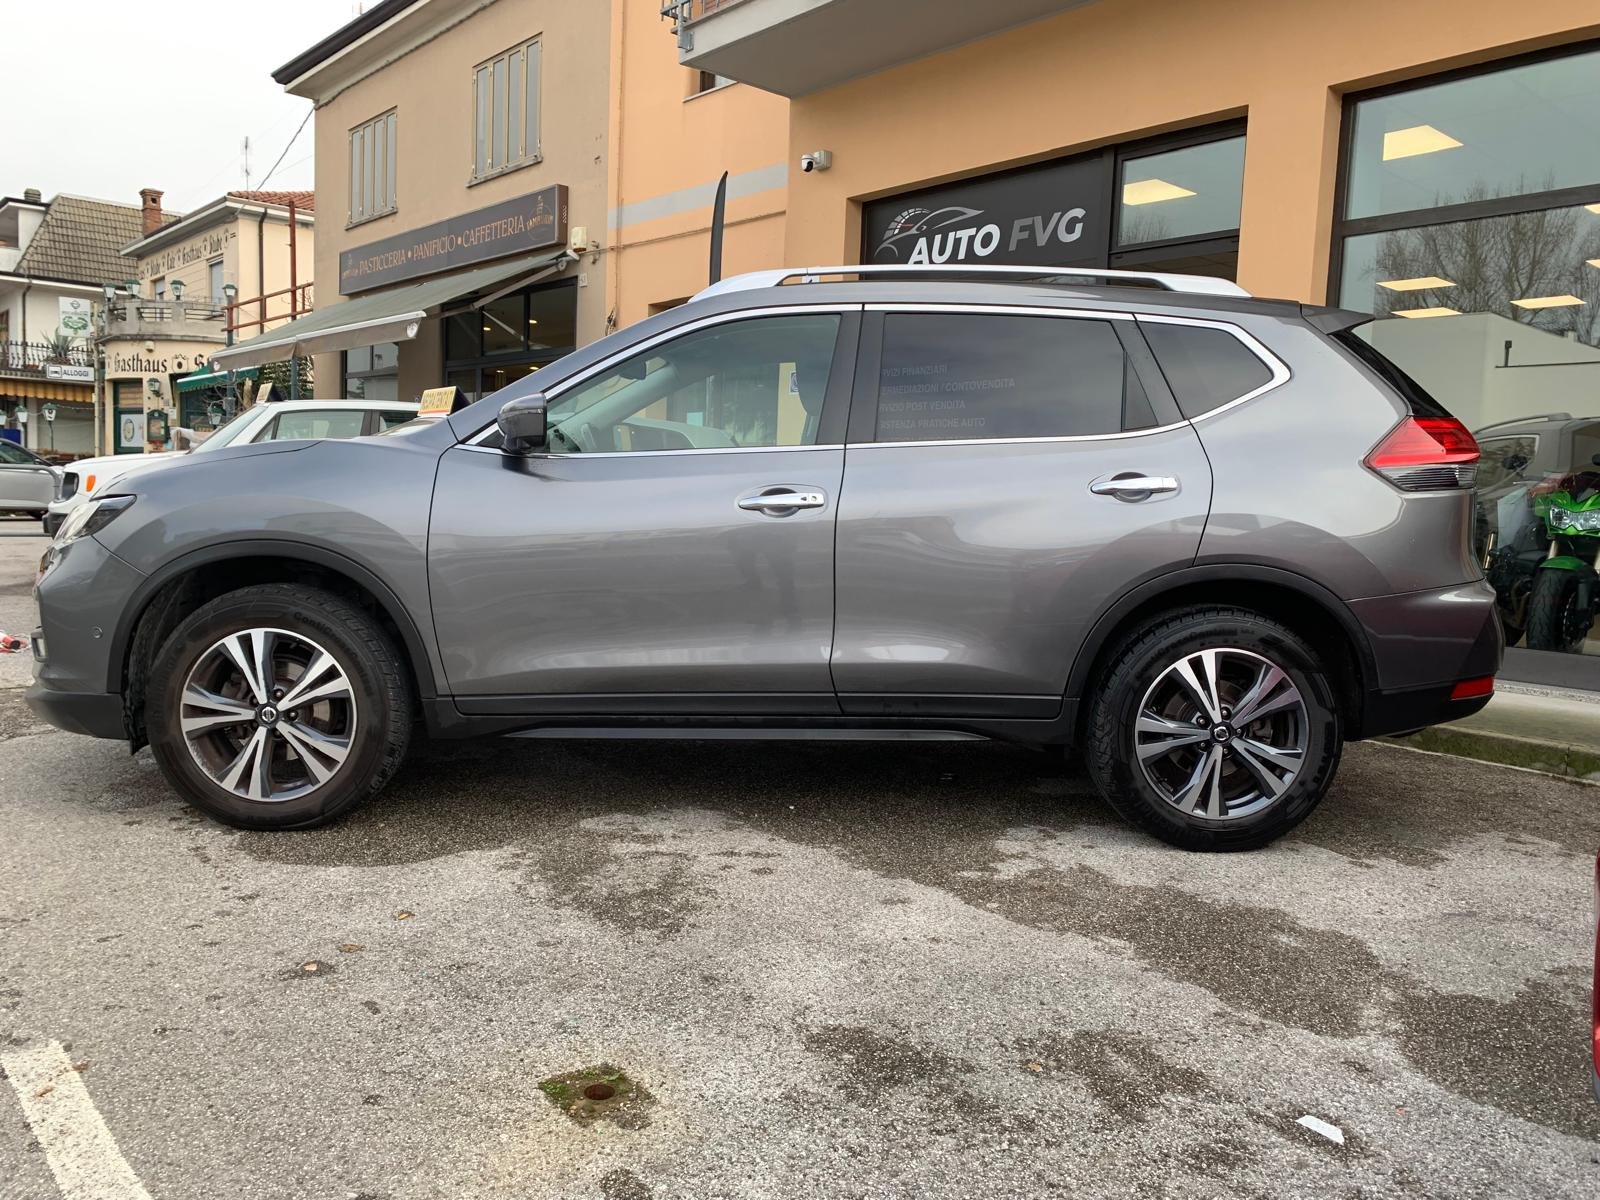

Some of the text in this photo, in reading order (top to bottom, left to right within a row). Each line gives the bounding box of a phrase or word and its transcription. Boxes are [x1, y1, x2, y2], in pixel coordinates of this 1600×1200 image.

[359, 250, 407, 276] PASTICCERIA
[413, 235, 456, 261] PANIFICIO
[462, 215, 525, 248] CAFFETTERIA
[908, 208, 1086, 264] AUTO FVG
[63, 368, 89, 377] ALLOGGI
[114, 352, 167, 374] Gasthaus
